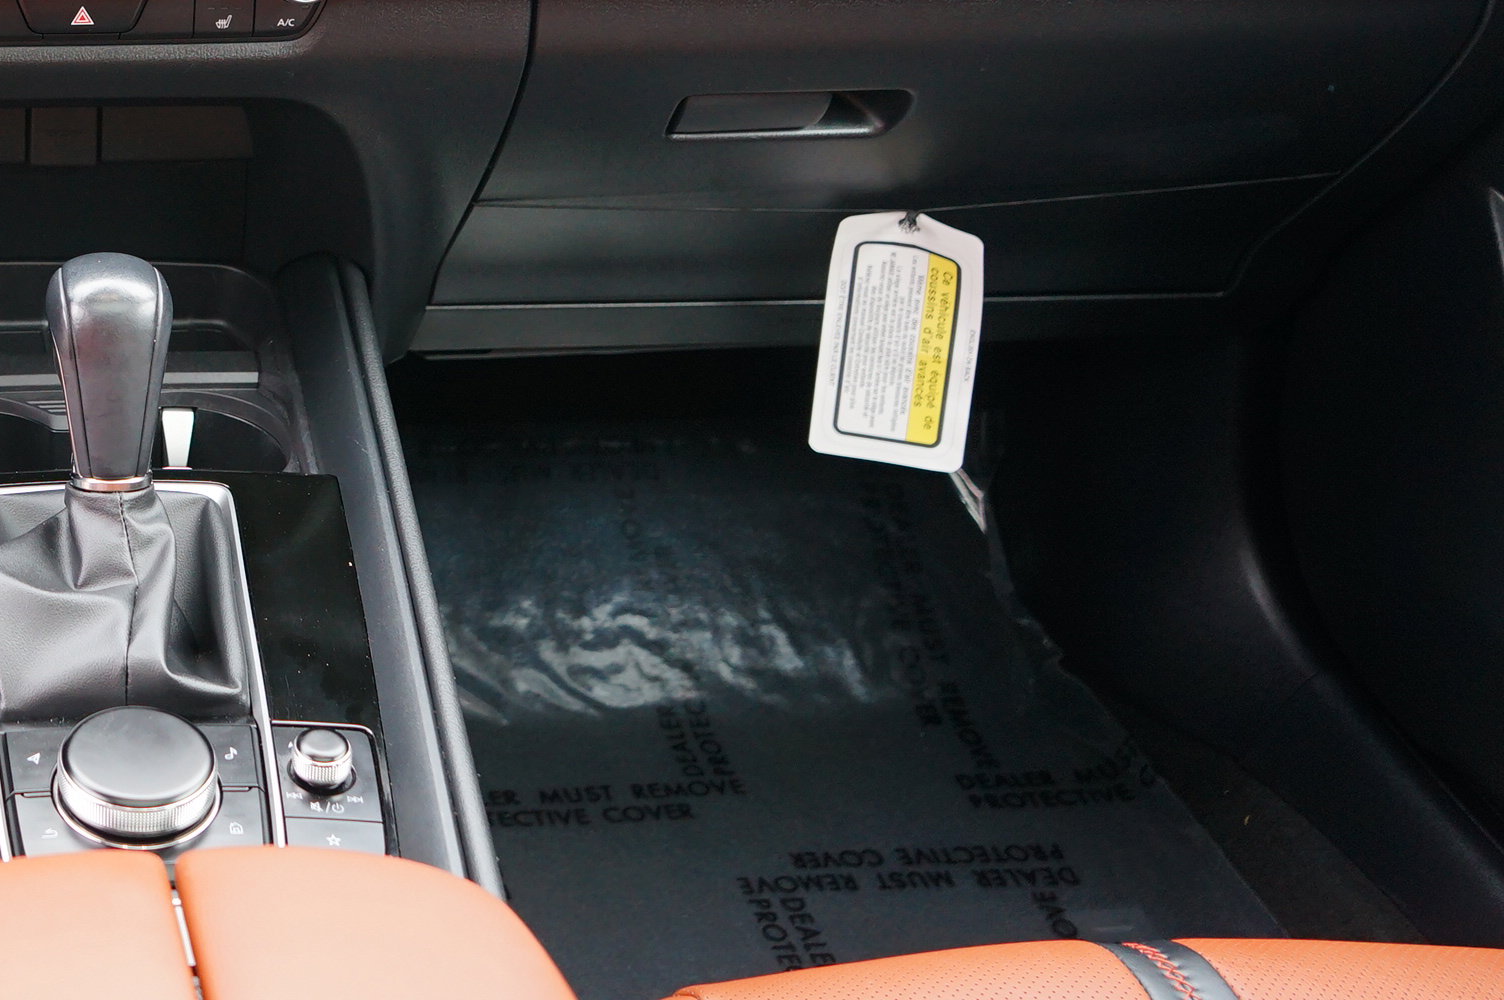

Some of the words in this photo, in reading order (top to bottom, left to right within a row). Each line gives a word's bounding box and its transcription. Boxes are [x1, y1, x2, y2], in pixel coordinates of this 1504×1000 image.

[276, 18, 295, 27] A/C
[941, 271, 953, 286] Ce
[924, 267, 940, 320] coussins
[932, 346, 943, 364] est
[923, 415, 935, 430] de
[684, 701, 735, 776] PROTEC
[539, 784, 614, 804] MUST
[630, 778, 747, 801] REMOVE
[487, 808, 593, 828] TECTIVE
[602, 802, 694, 823] COVER
[789, 848, 885, 870] COVER
[896, 843, 1065, 866] PROTECTIVE
[736, 874, 860, 896] REMOVE
[876, 871, 956, 891] MUST
[972, 866, 1080, 888] DEALER
[1031, 891, 1078, 940] OVE
[747, 898, 803, 971] PROTE
[779, 896, 838, 968] DEALE
